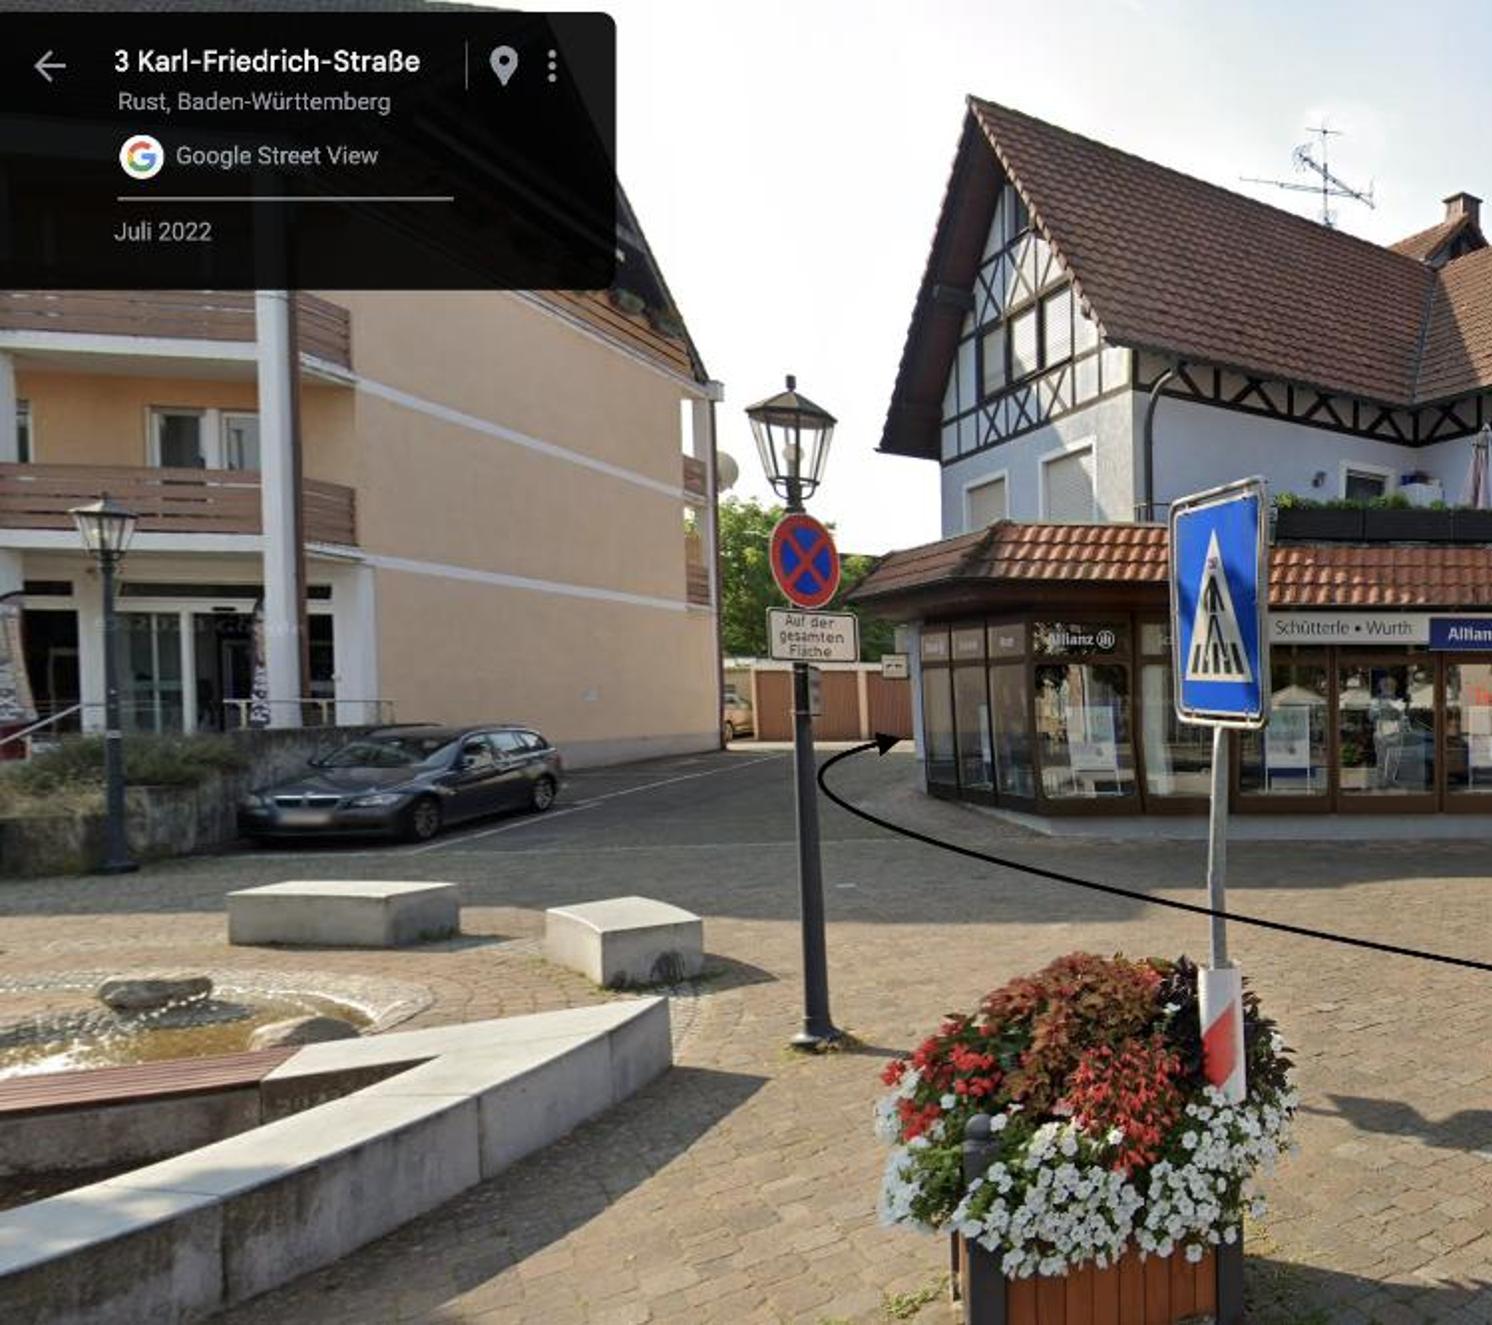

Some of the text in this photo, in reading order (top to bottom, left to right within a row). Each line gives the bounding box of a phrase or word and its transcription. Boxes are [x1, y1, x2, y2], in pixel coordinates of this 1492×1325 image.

[785, 614, 835, 629] Auf der
[1274, 619, 1350, 637] Schütterle
[779, 630, 845, 644] gesamten
[1048, 630, 1095, 647] Allianz
[789, 644, 833, 658] Fläche
